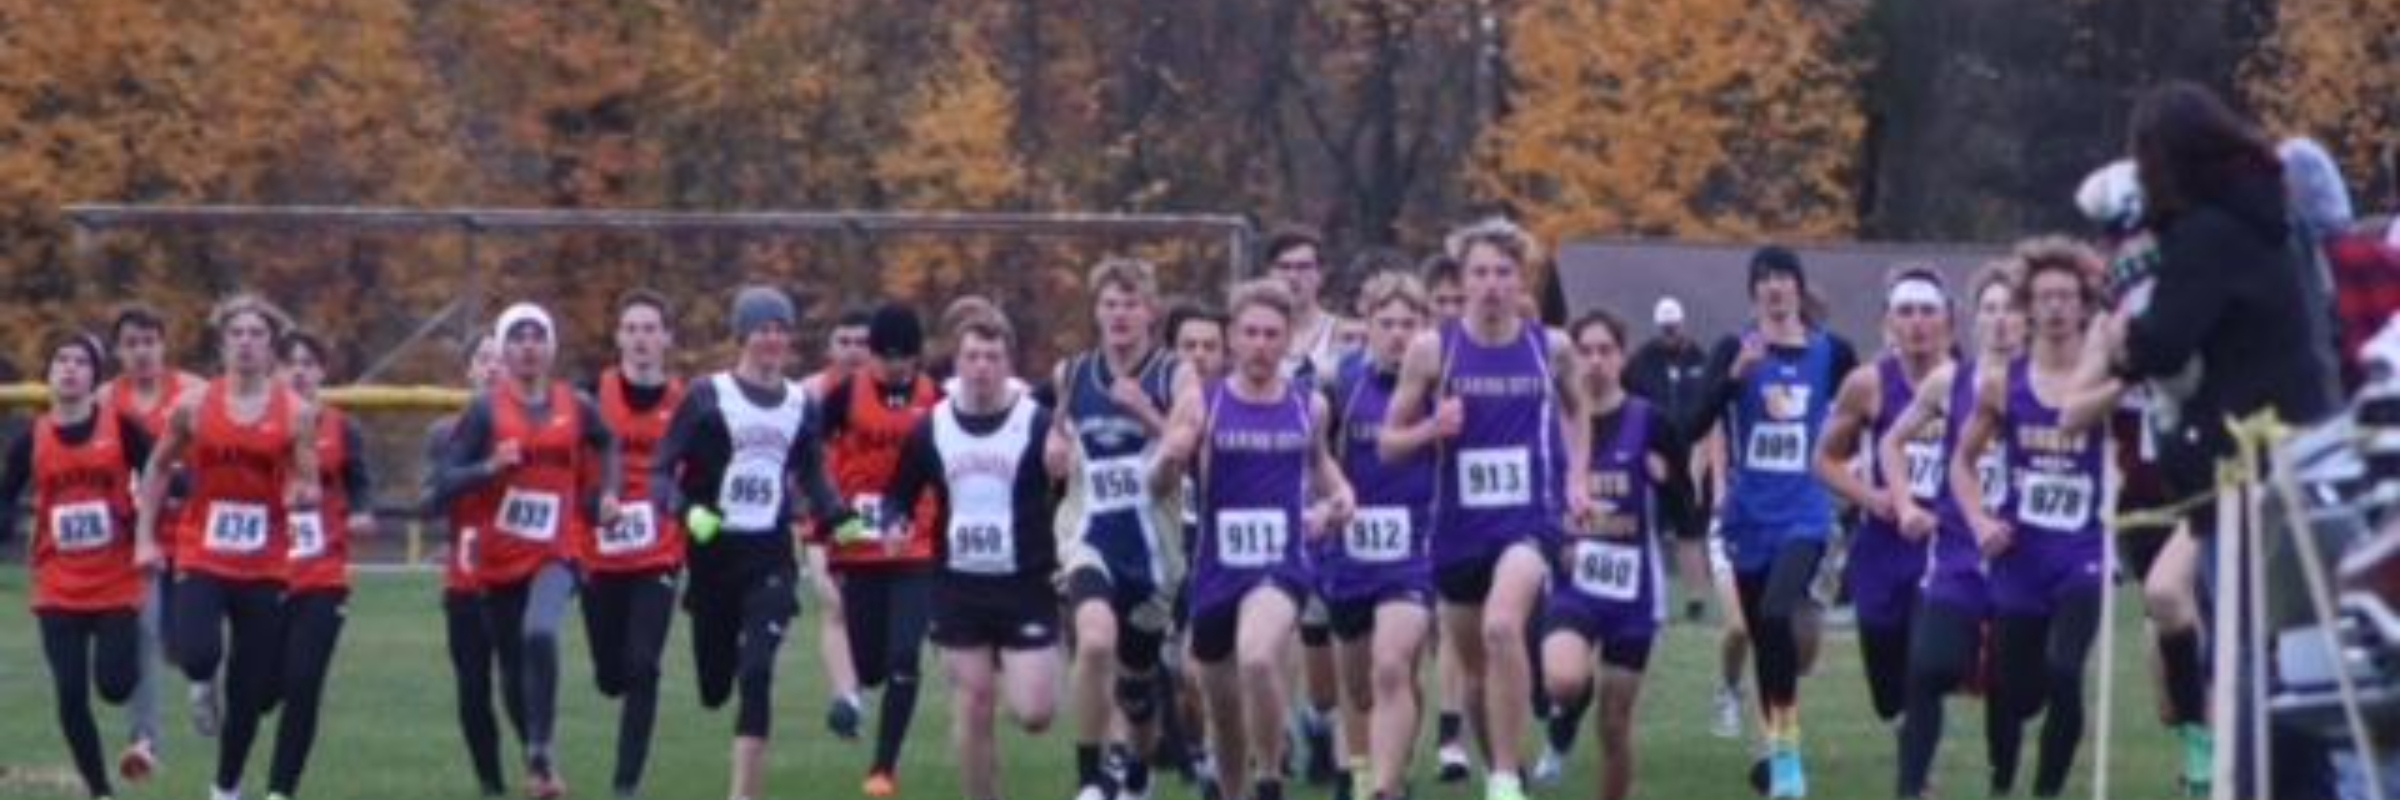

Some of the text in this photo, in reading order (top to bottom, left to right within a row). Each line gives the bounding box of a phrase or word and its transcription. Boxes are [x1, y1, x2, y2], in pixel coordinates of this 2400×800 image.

[731, 475, 773, 506] 965
[1469, 462, 1521, 494] 913
[956, 526, 1002, 556] 960
[1227, 523, 1276, 555] 911
[1352, 520, 1400, 551] 912
